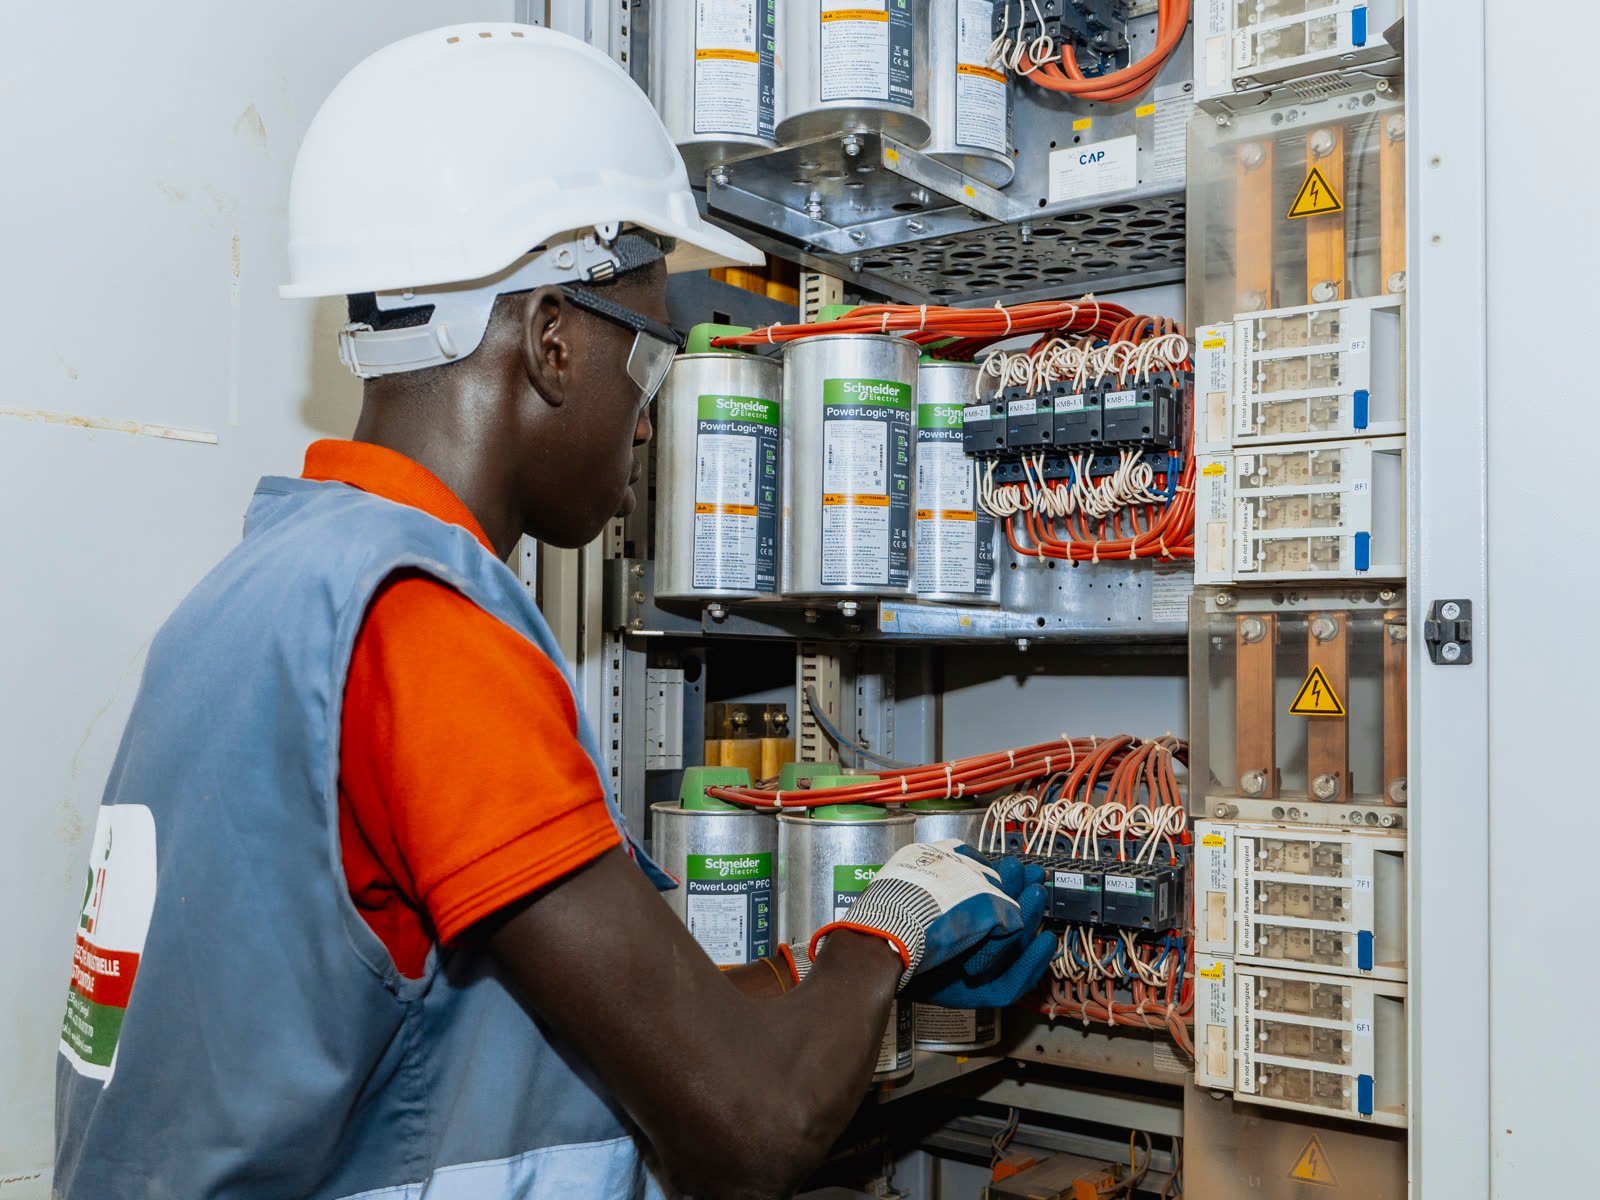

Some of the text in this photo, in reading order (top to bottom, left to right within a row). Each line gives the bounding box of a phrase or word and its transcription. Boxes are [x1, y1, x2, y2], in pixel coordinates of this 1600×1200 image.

[1079, 151, 1105, 165] CAP
[1351, 341, 1366, 350] 8F2
[843, 382, 900, 396] Schneider
[869, 394, 899, 403] Electric
[1106, 394, 1135, 404] KM8-1.2
[716, 398, 769, 412] Schneider
[1009, 403, 1035, 412] KM8-2.2
[1056, 399, 1082, 408] KM8-1.1
[741, 410, 768, 419] Electric
[895, 411, 910, 421] PFC
[965, 409, 988, 418] KM8-2.1
[1241, 420, 1247, 428] do
[764, 426, 778, 437] PFC
[1242, 556, 1248, 564] do
[705, 858, 760, 869] Schneider
[755, 879, 770, 889] PFC
[1055, 876, 1082, 885] KM7-1.1
[1106, 880, 1134, 889] KM7-1.2
[1357, 880, 1370, 888] 7F1
[1244, 940, 1249, 948] do
[1356, 1024, 1370, 1032] 6F1
[1244, 1078, 1250, 1086] do
